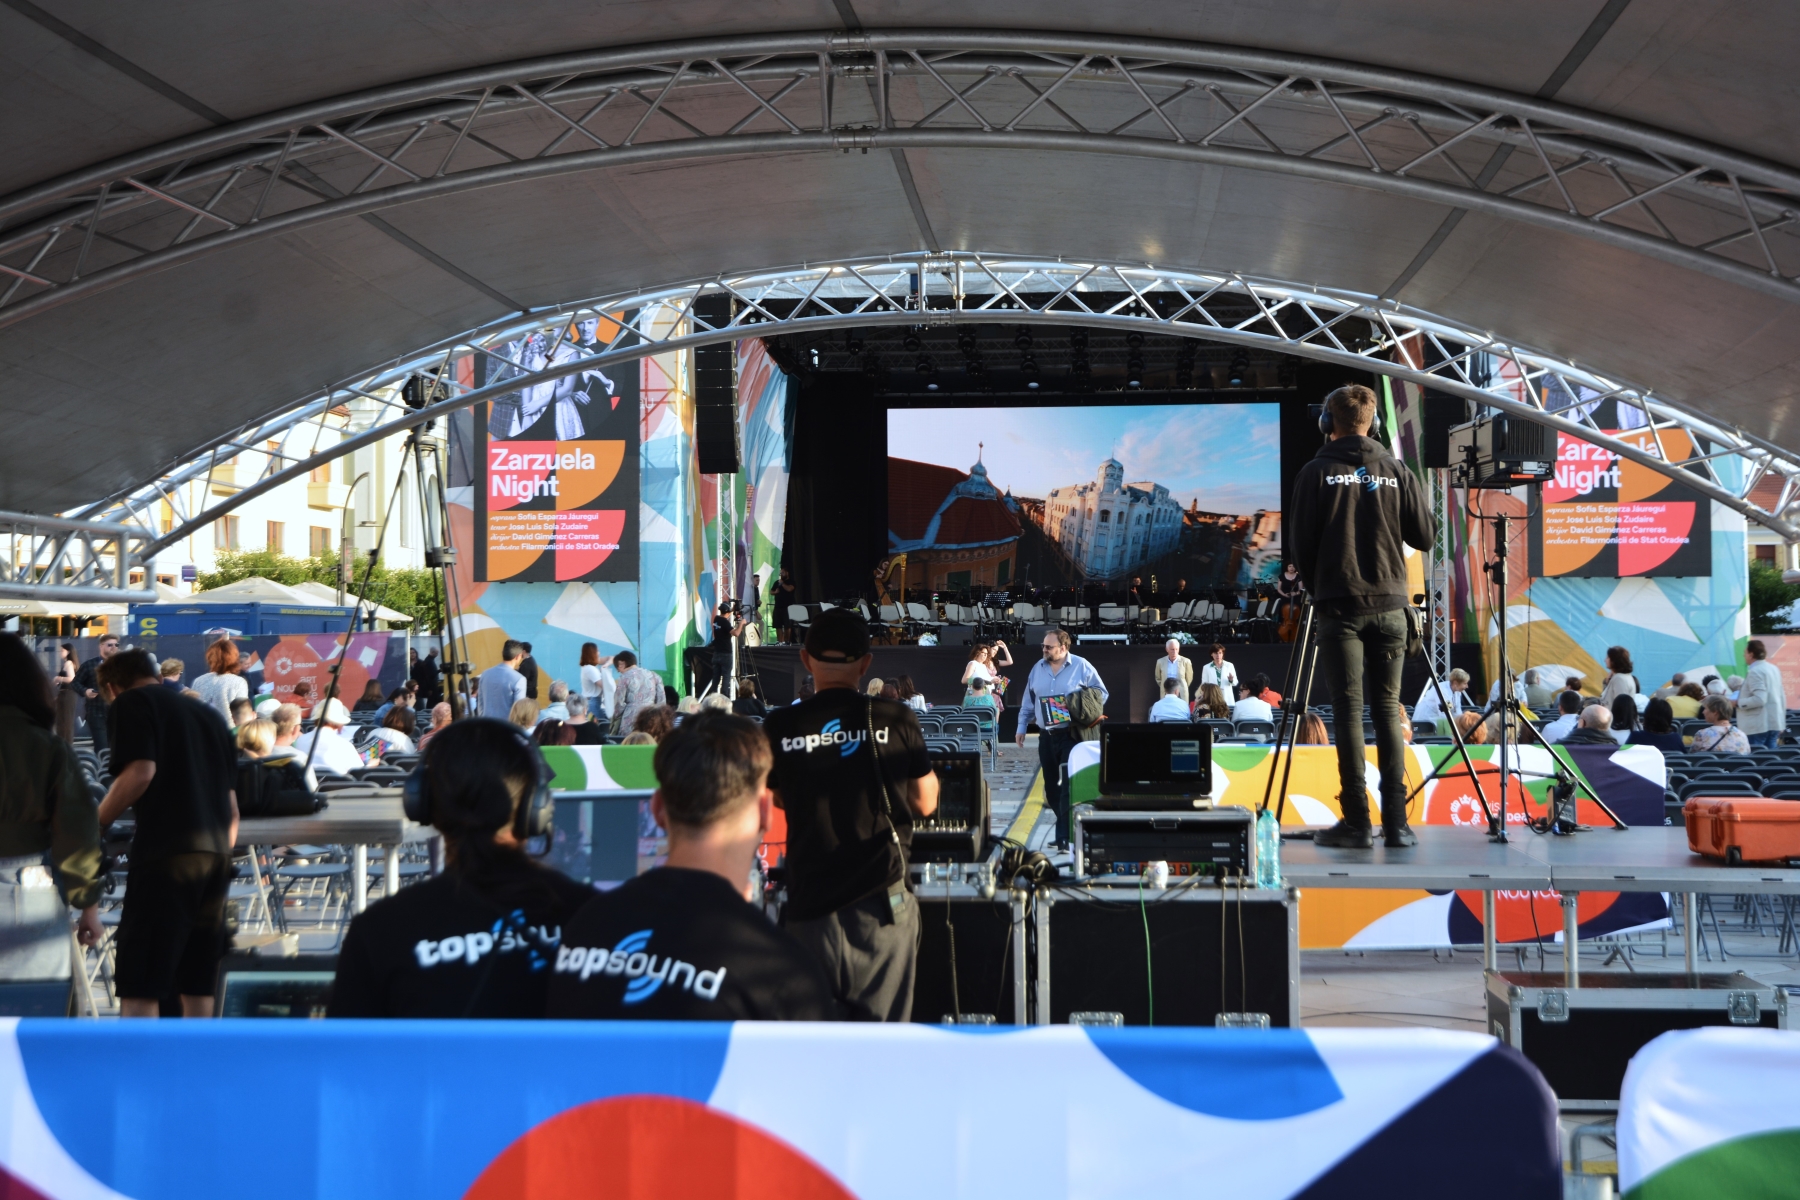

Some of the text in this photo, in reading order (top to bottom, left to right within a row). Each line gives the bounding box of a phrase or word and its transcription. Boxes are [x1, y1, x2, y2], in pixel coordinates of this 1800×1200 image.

[491, 448, 595, 471] Zarzuela
[1326, 474, 1398, 488] topsound
[1548, 465, 1622, 495] Night
[492, 474, 560, 503] Night
[1598, 506, 1630, 514] Esparza
[538, 514, 567, 522] Esparza
[1566, 516, 1584, 524] Jose
[1624, 515, 1654, 523] Zudaire
[1570, 526, 1593, 534] David
[1595, 526, 1630, 534] Giménez
[1628, 536, 1639, 544] de
[1640, 536, 1658, 544] Stat
[1660, 536, 1689, 544] Oradea
[555, 944, 727, 999] topsound
